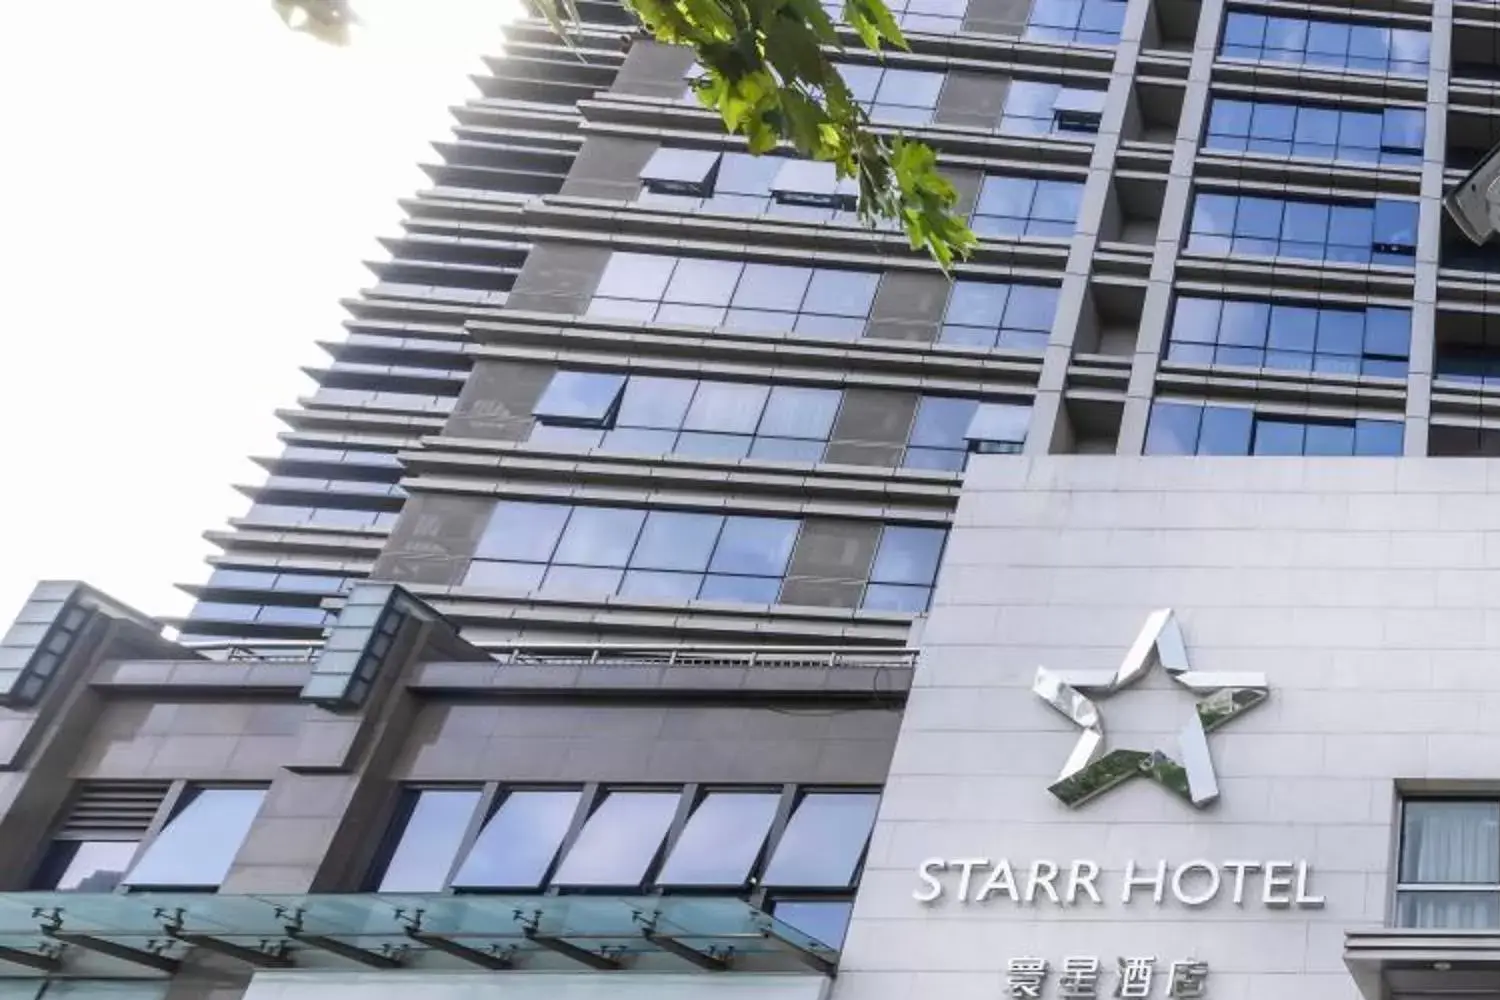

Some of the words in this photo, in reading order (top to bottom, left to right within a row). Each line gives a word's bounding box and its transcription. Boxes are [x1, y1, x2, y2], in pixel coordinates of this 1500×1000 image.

[912, 857, 1102, 905] STARR
[1121, 858, 1326, 906] HOTEL
[1004, 955, 1208, 1000] 寰星酒店
